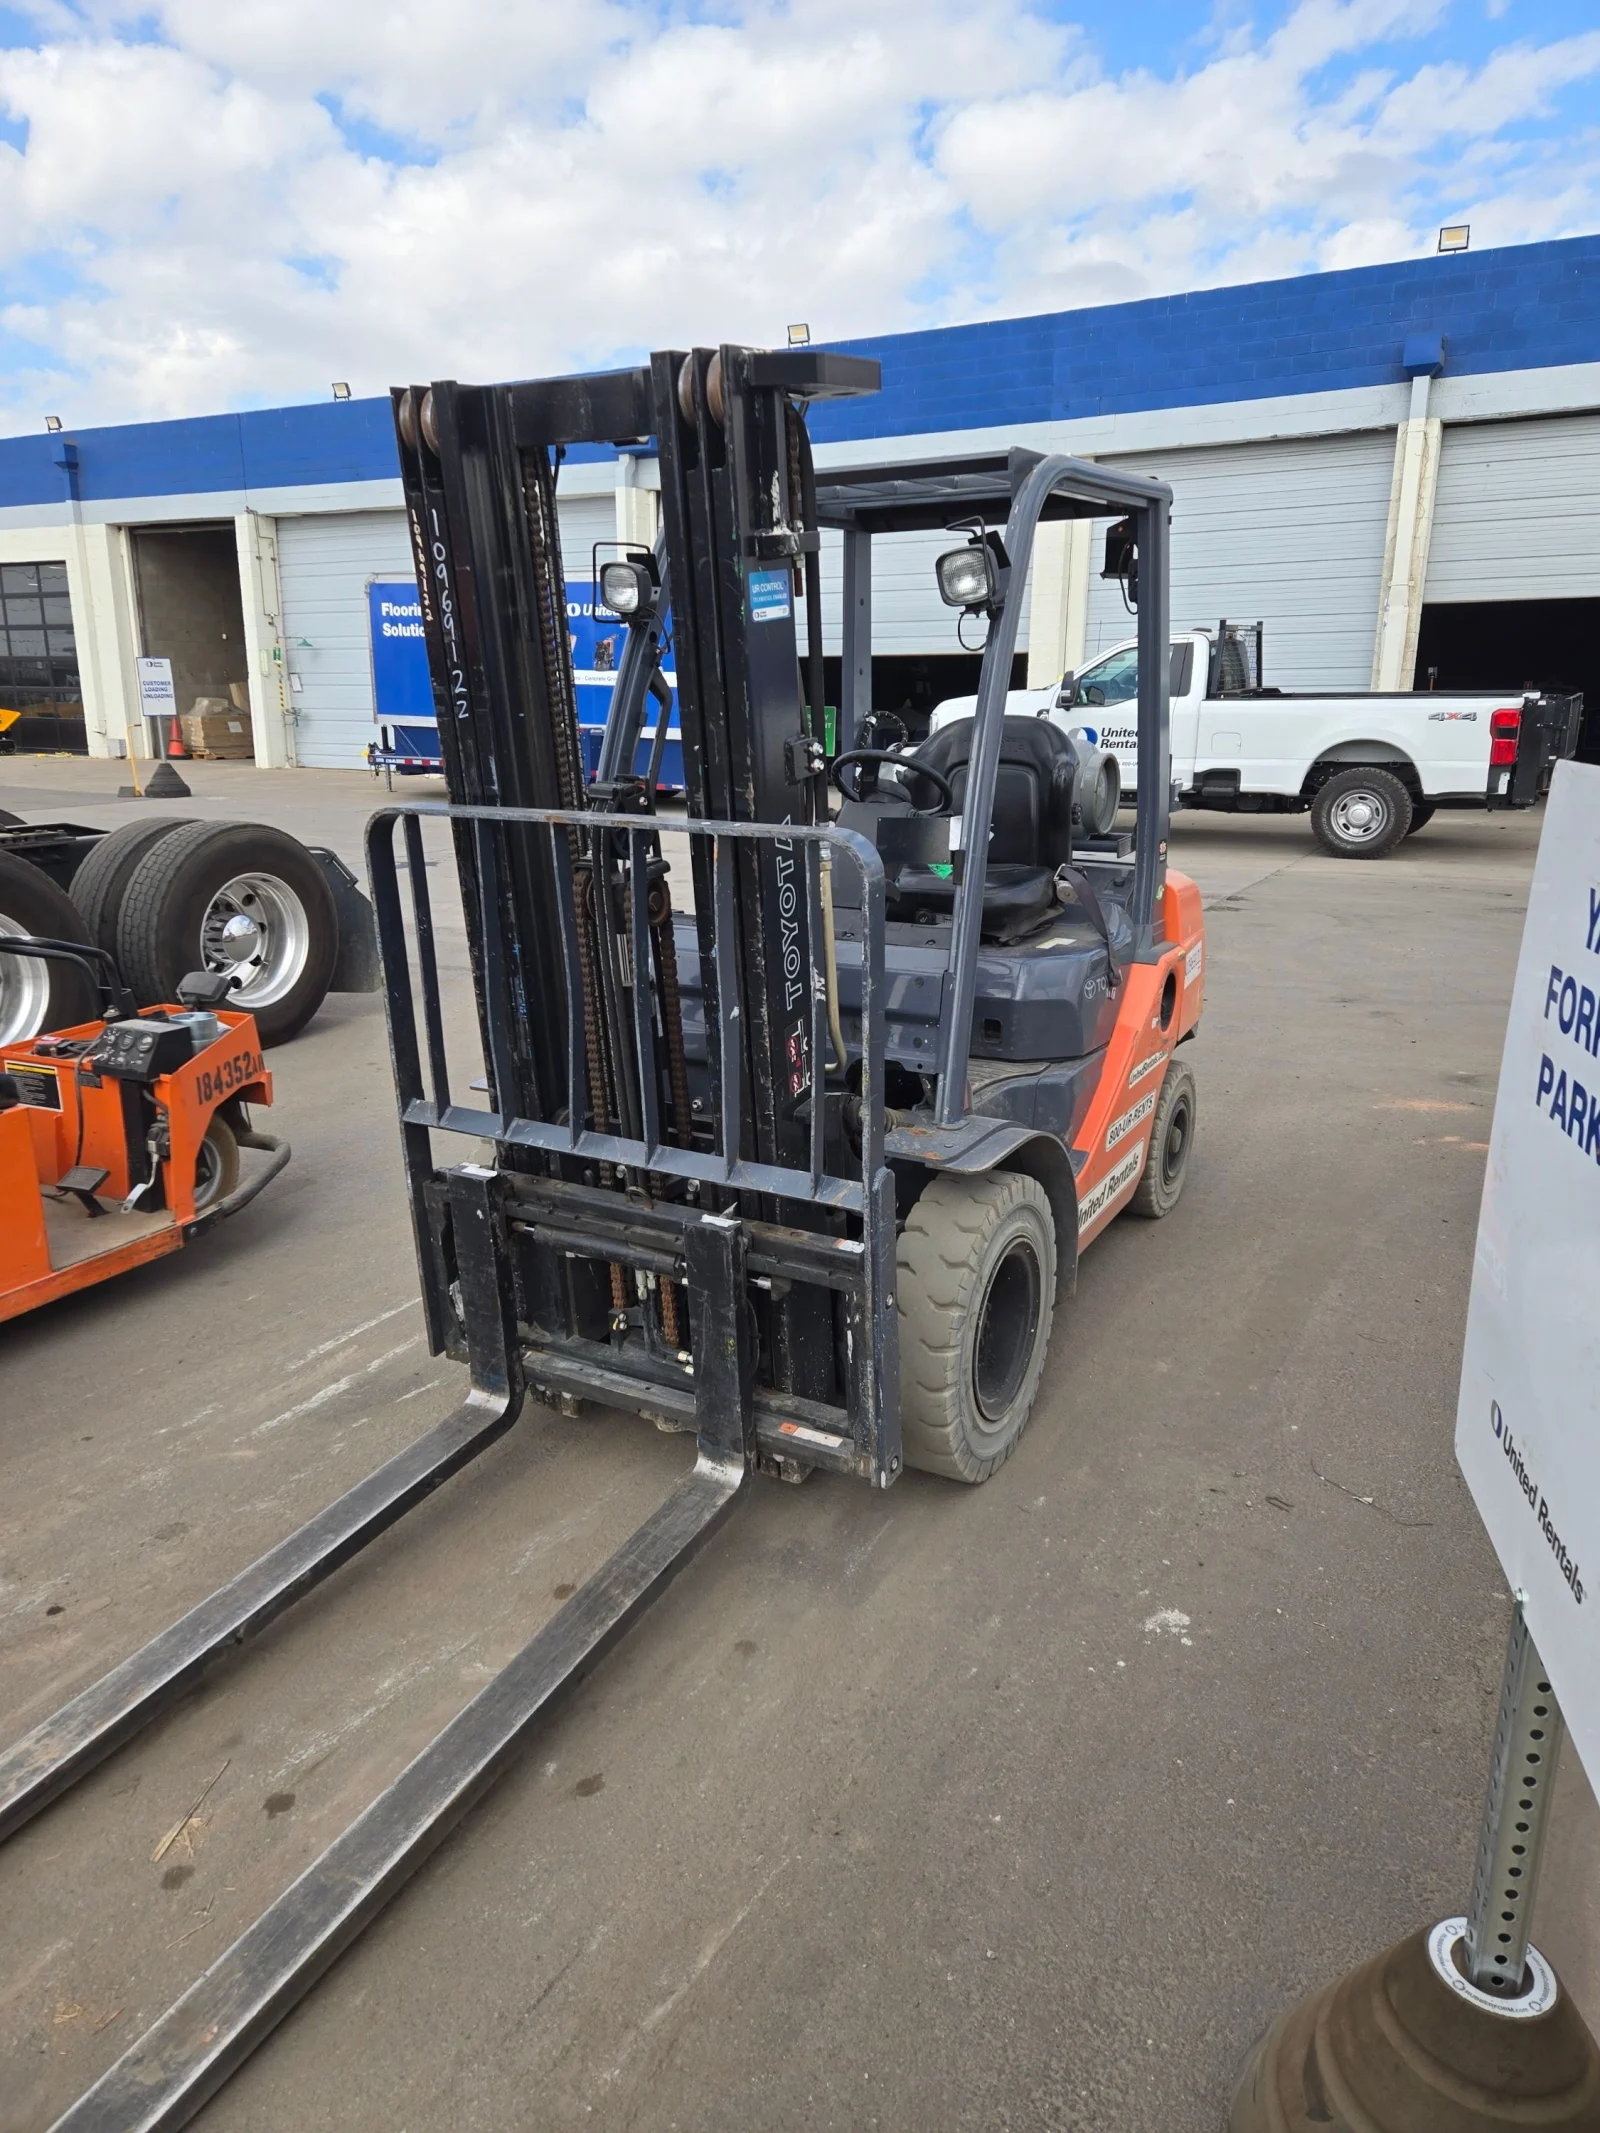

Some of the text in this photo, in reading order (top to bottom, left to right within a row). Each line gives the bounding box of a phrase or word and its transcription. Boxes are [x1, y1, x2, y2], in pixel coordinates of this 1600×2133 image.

[761, 582, 784, 592] CONTROL
[431, 508, 469, 719] 10969122
[1100, 738, 1138, 749] Renta
[775, 814, 803, 1011] TOYOTA
[1108, 1094, 1154, 1145] 800-UR-RENTS
[1106, 1152, 1140, 1200] Rentals
[1503, 1425, 1584, 1605] United Rentals
[1464, 1990, 1530, 2013] RUBBERFORM.com
